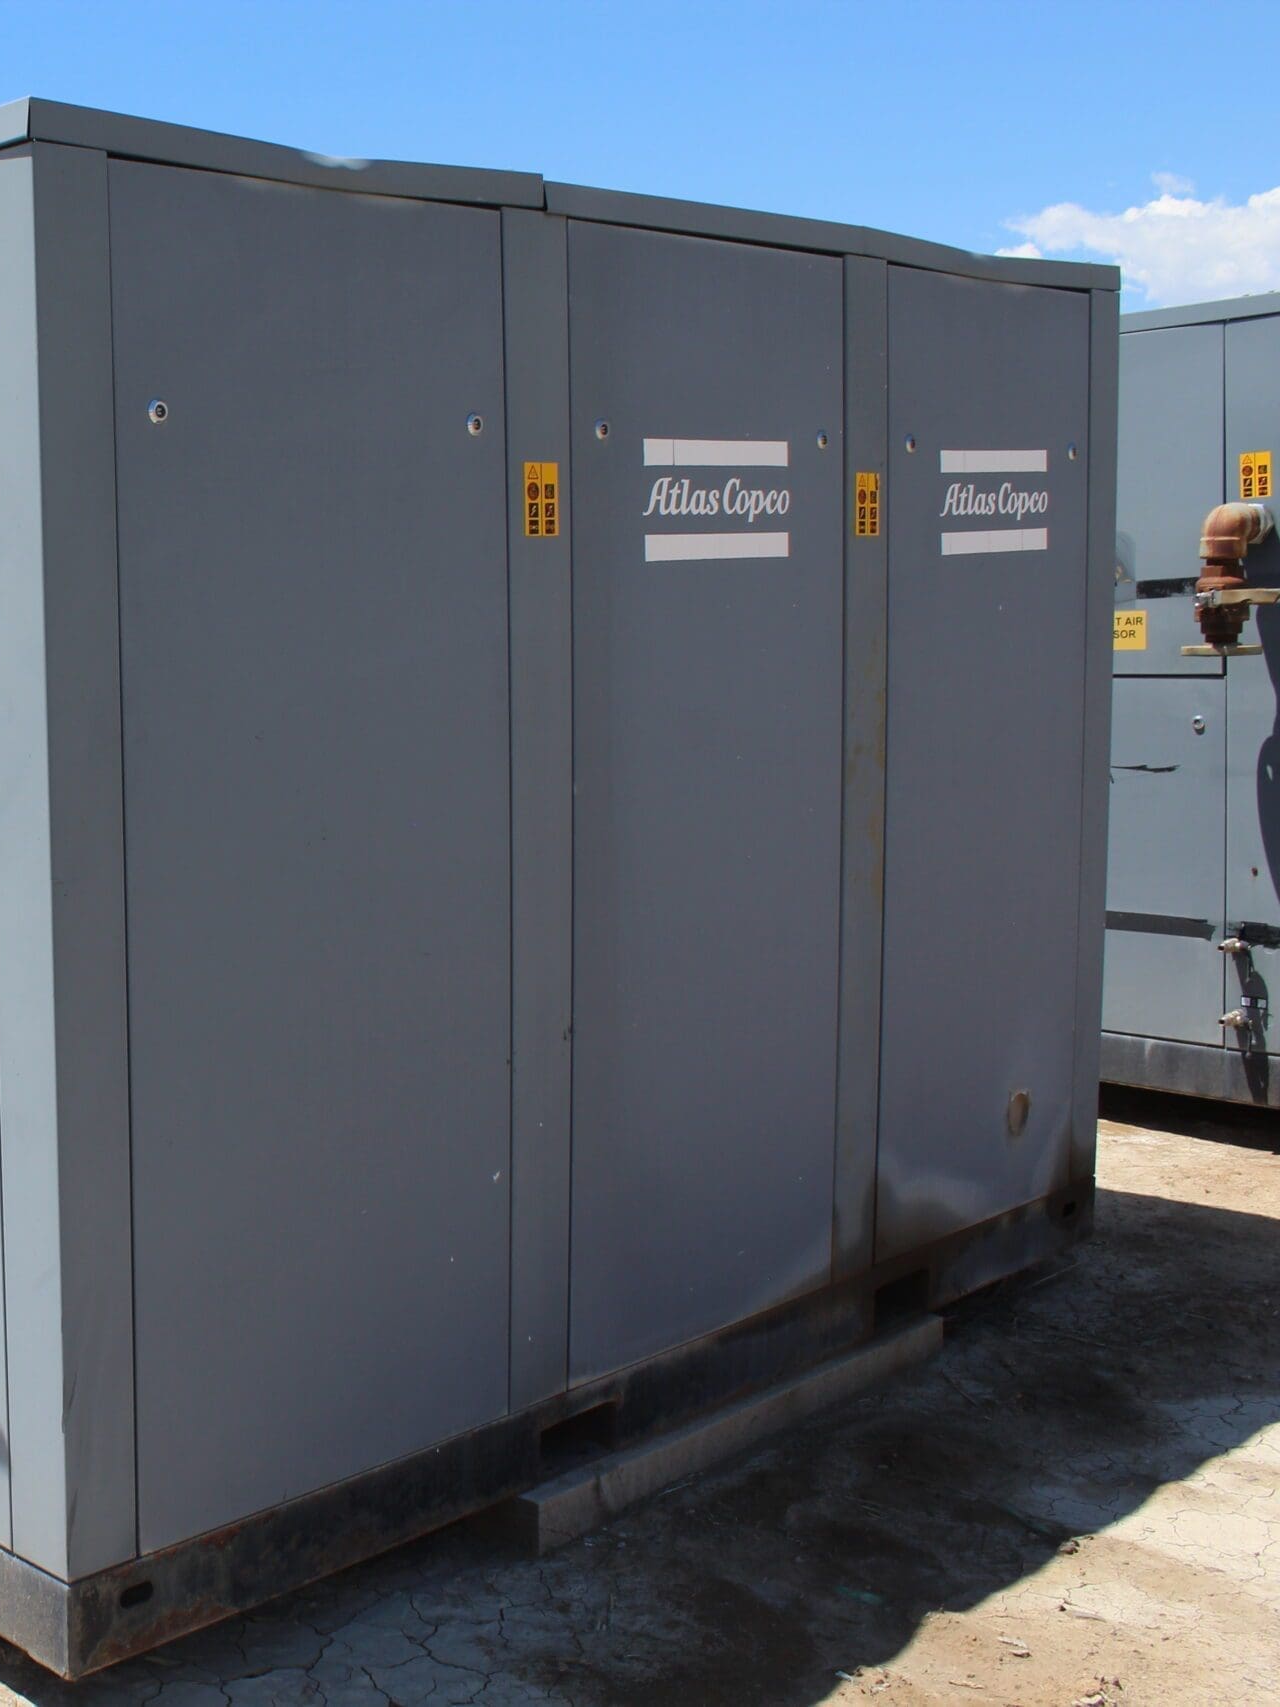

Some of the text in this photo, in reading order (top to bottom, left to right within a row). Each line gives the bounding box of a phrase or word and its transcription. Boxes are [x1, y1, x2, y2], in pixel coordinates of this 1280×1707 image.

[642, 476, 790, 523] Atlas Copco
[939, 482, 1048, 521] Atlas Copco
[1125, 616, 1144, 626] AIR
[1112, 629, 1137, 639] SOR
